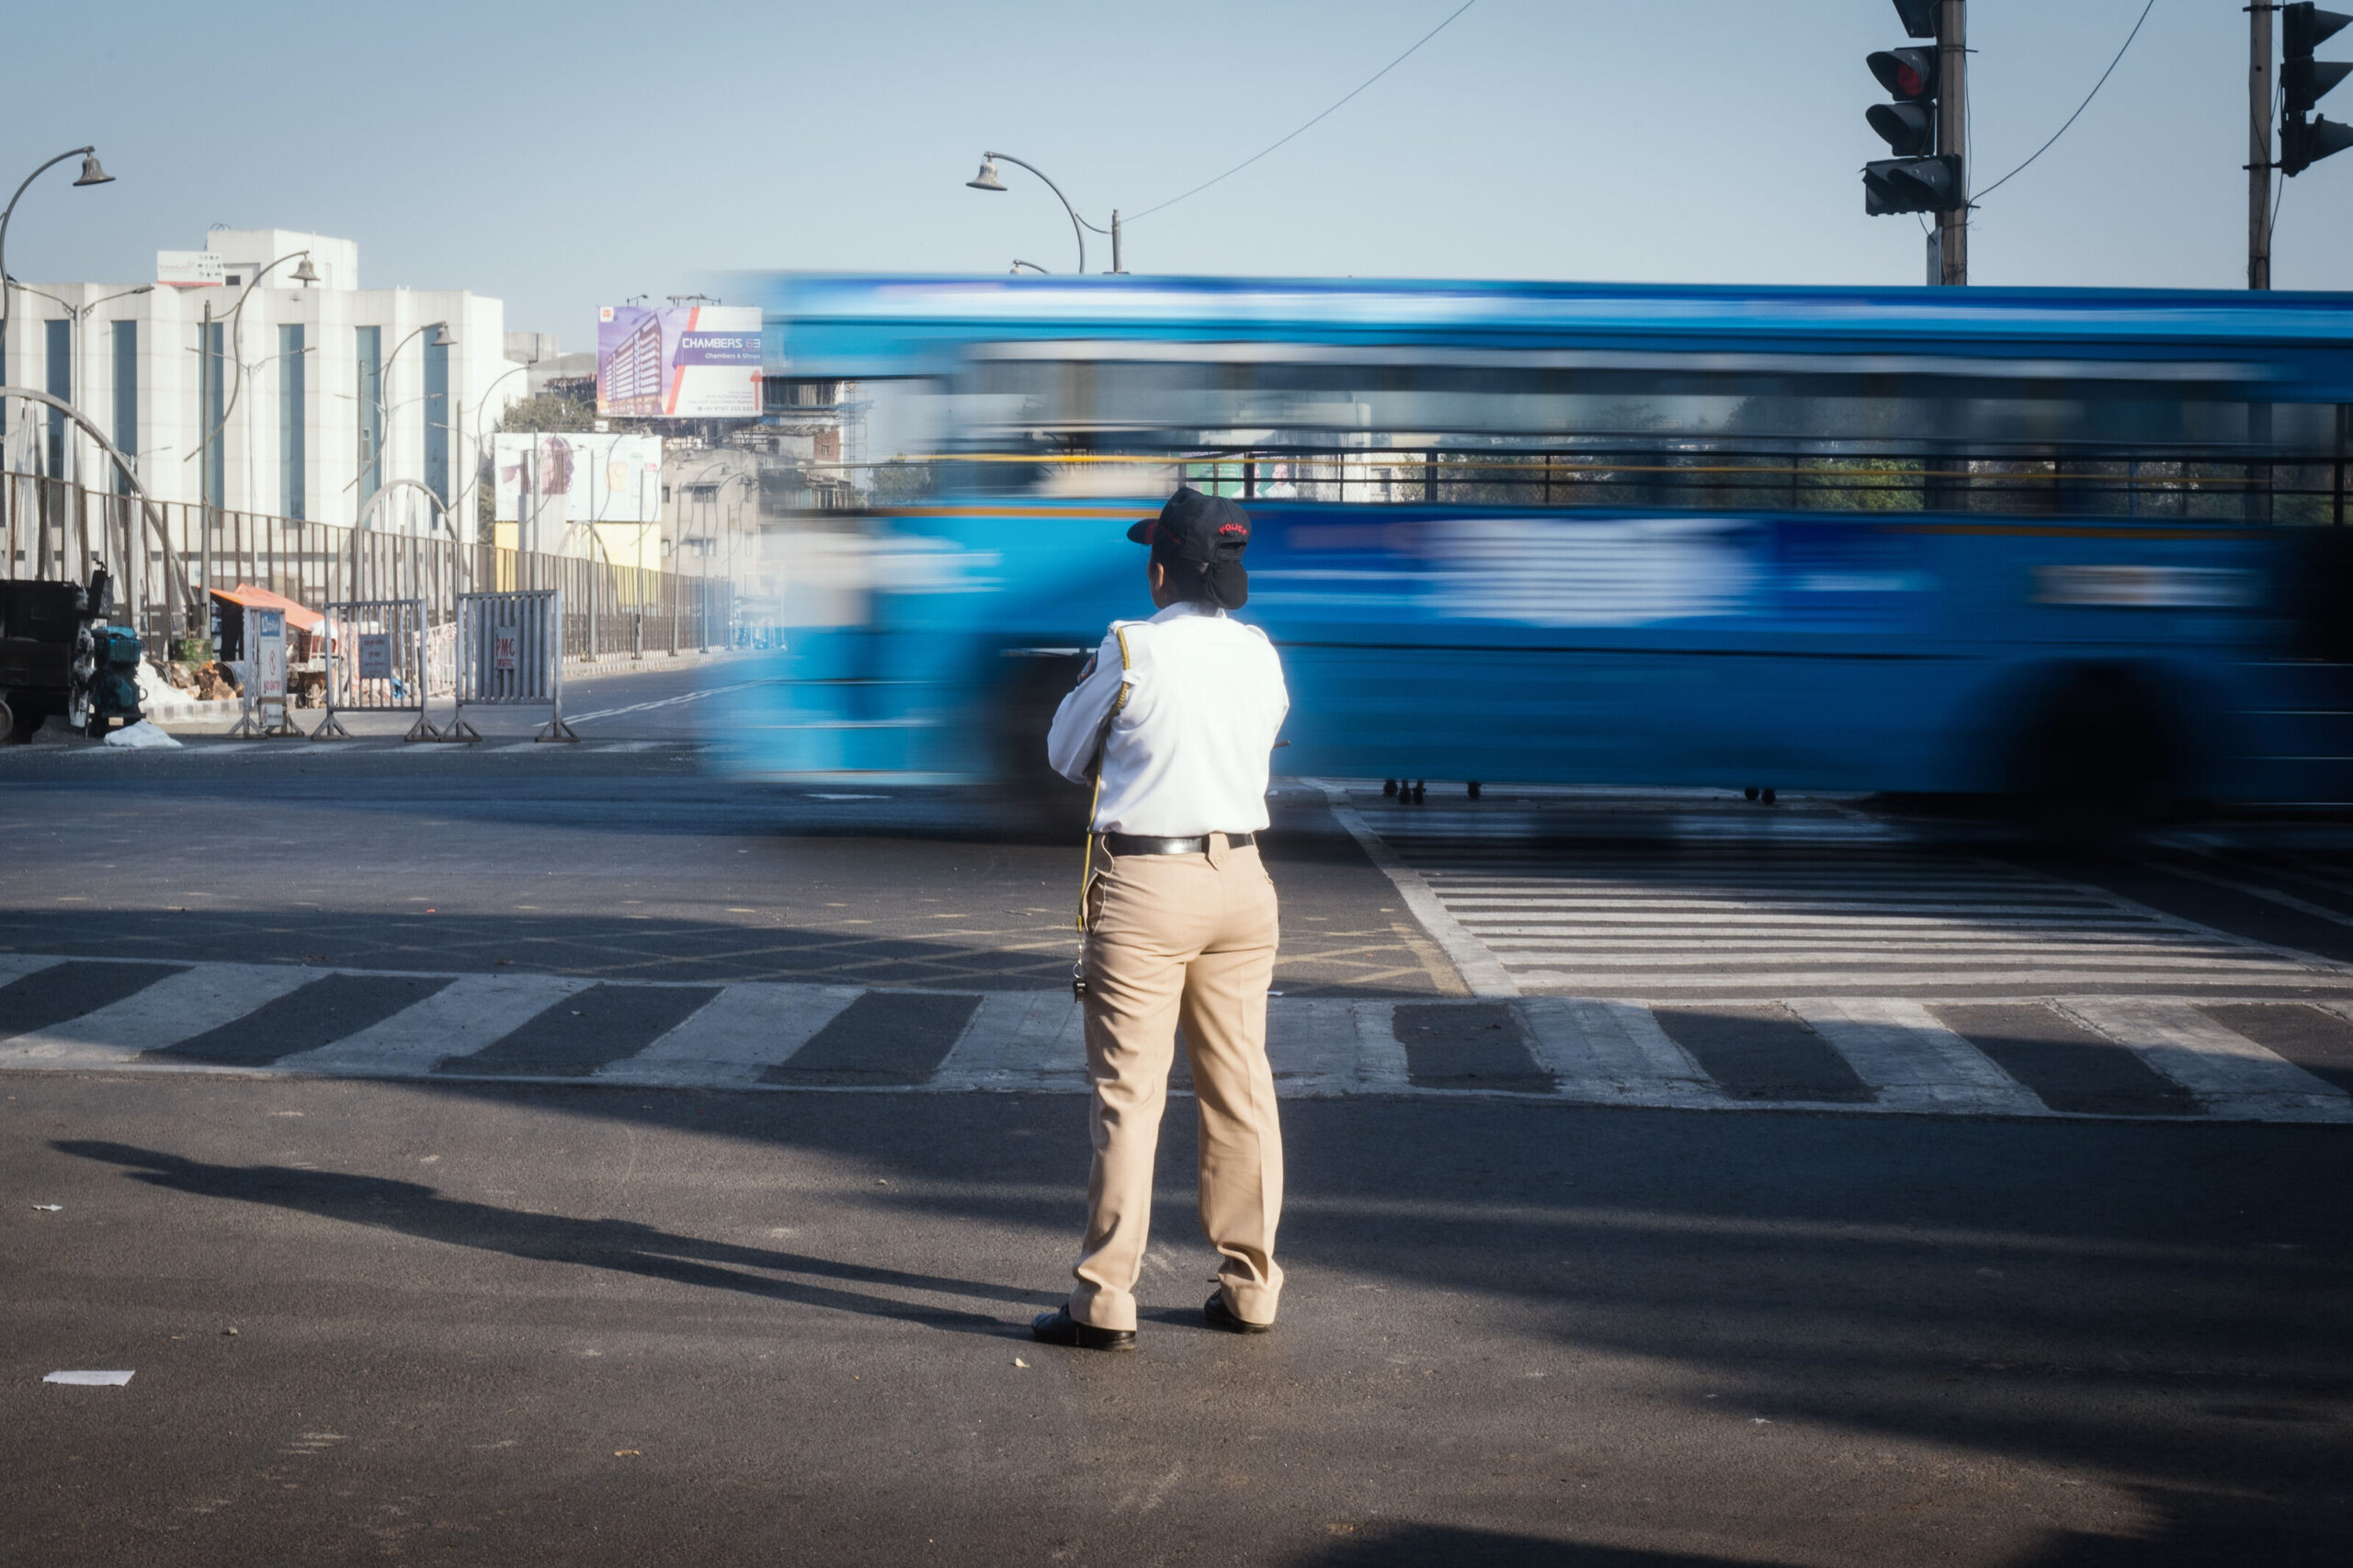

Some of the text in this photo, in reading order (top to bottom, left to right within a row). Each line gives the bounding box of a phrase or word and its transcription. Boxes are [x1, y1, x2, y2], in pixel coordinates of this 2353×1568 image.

[682, 337, 743, 348] CHAMBERS
[1219, 522, 1247, 536] POLICE
[495, 638, 515, 656] PMC
[263, 680, 281, 691] NO ENTRY
